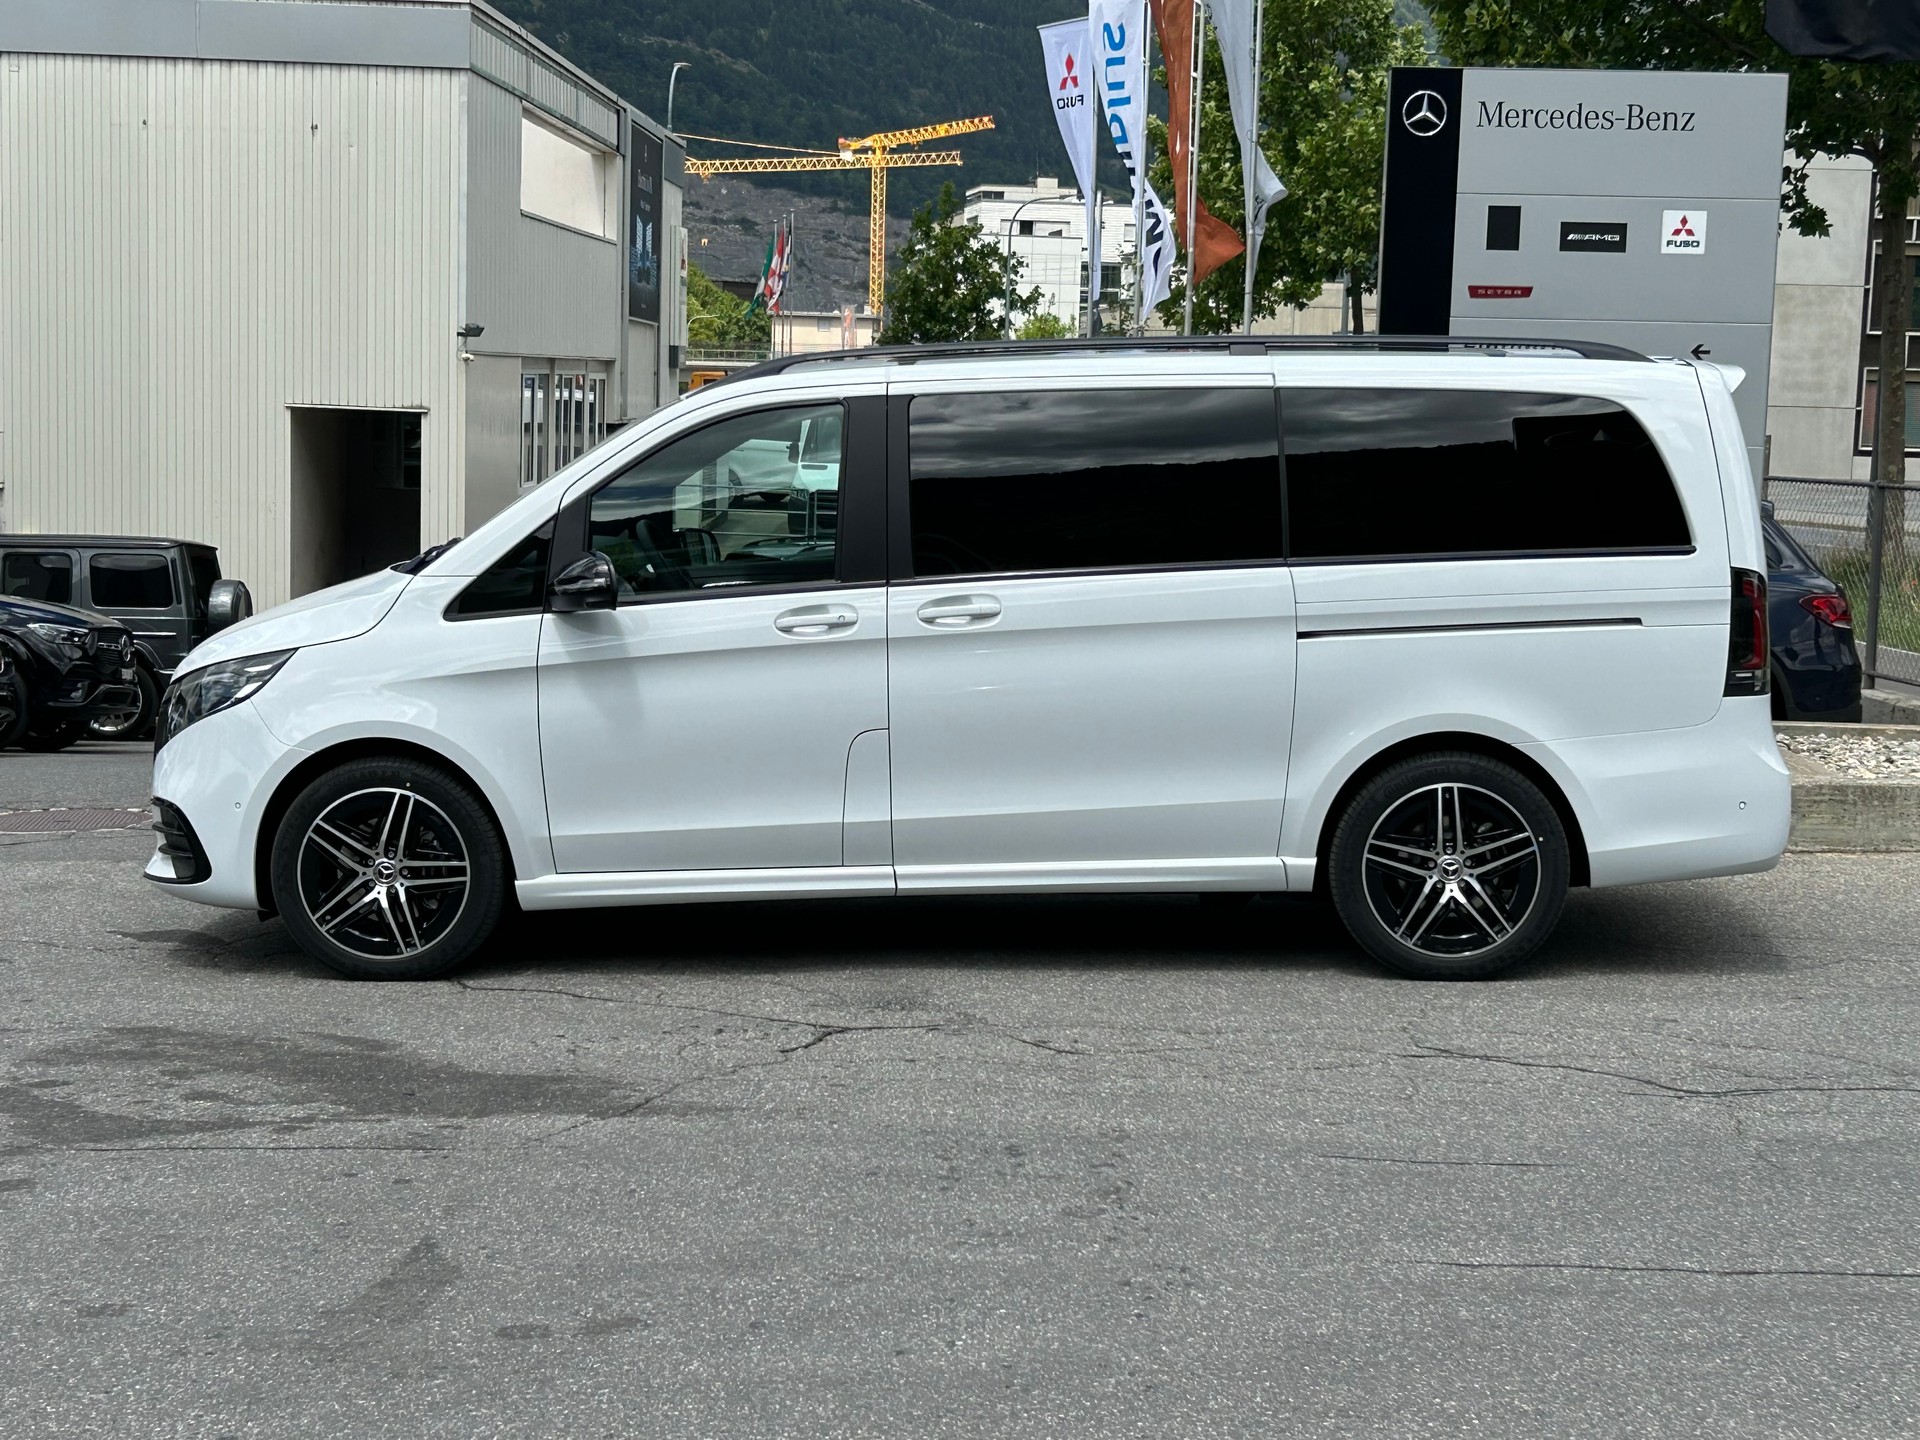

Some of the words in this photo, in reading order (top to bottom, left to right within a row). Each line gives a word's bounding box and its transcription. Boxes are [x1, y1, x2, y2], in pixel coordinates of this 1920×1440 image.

[1475, 100, 1697, 132] Mercedes-Benz
[1582, 233, 1620, 242] AMG
[1666, 239, 1701, 248] FUSO
